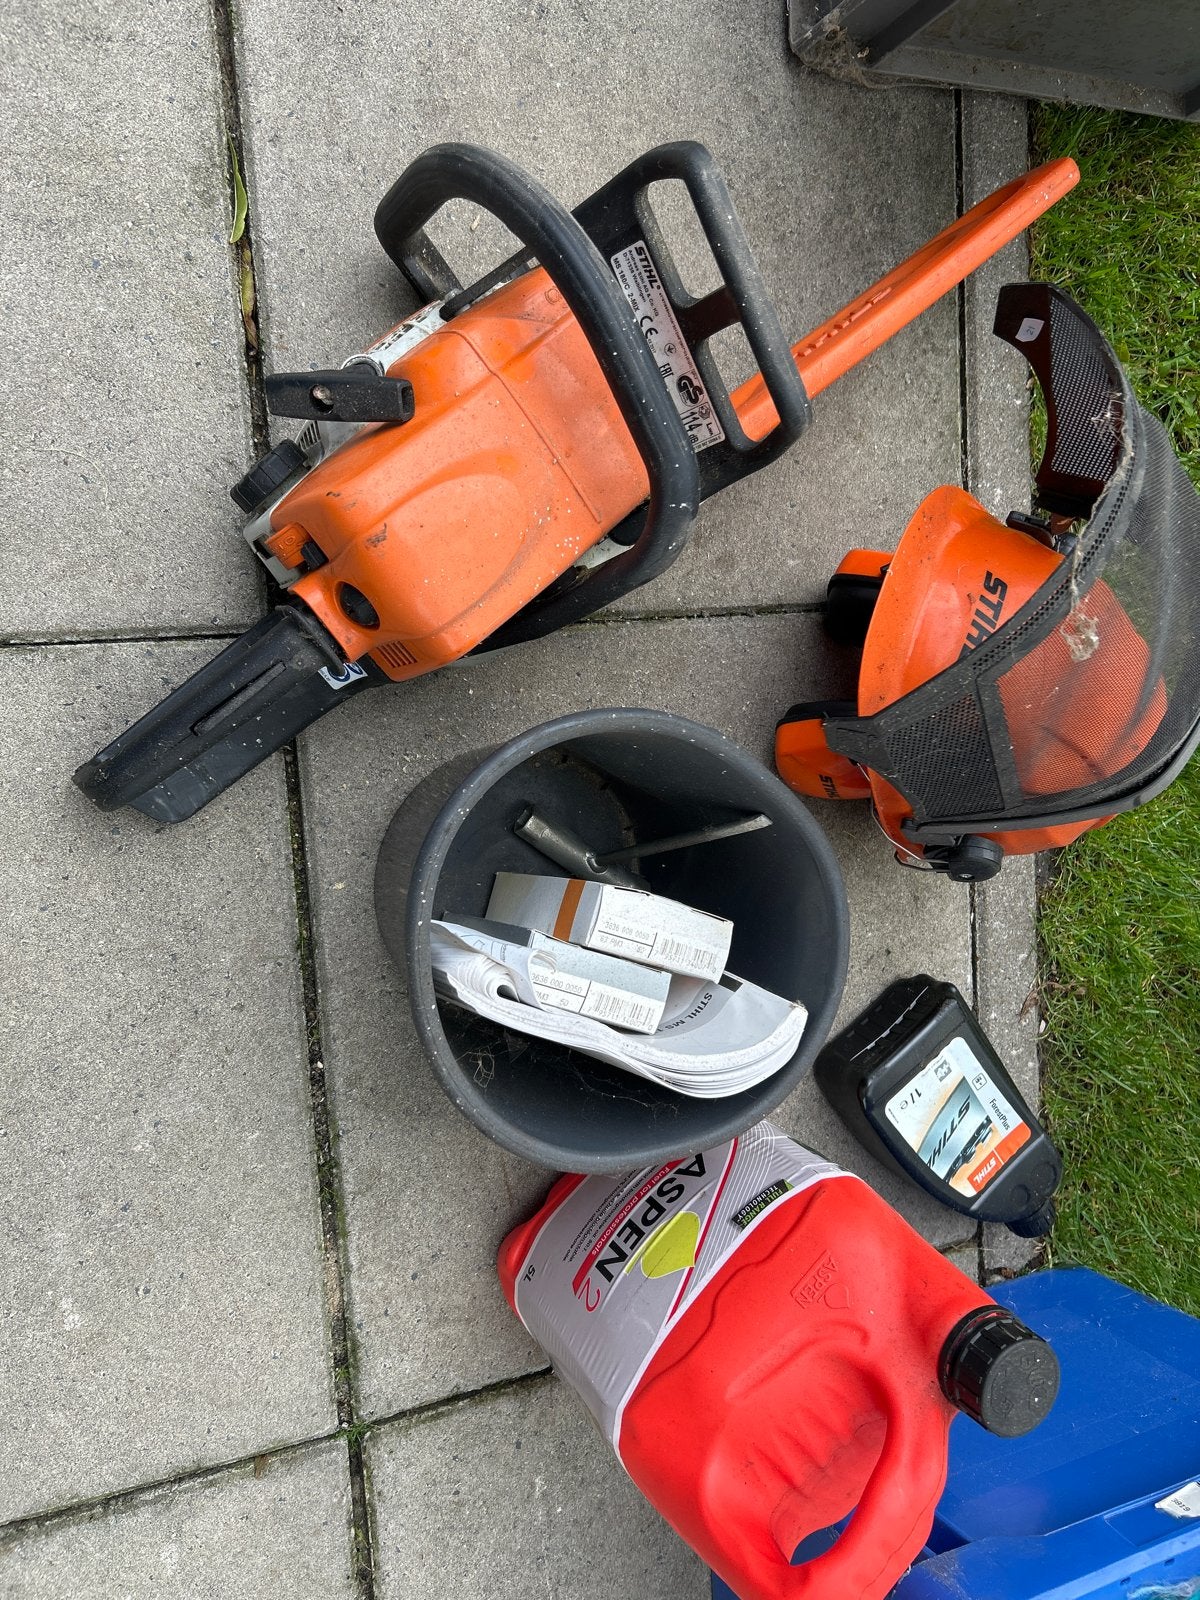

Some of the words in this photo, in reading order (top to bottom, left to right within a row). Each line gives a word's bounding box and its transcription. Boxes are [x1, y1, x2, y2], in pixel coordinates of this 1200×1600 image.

[612, 257, 622, 270] MS
[618, 270, 631, 291] 180/C
[627, 249, 640, 272] Andreas
[637, 271, 646, 285] Stihl
[634, 246, 658, 289] STIHL
[631, 273, 647, 303] Waiblingen
[680, 409, 703, 434] 114
[684, 992, 713, 1022] STIHL
[989, 1098, 1011, 1131] ForestPlus
[650, 1165, 671, 1185] Fuel
[973, 1156, 997, 1184] STIHL
[638, 1182, 652, 1197] for
[764, 1188, 784, 1203] FULL
[590, 1194, 640, 1257] professionals
[595, 1153, 707, 1284] ASPEN
[740, 1201, 766, 1227] RANGE
[523, 1265, 537, 1283] 5L
[794, 1256, 838, 1310] ASPEN
[577, 1277, 602, 1314] 2
